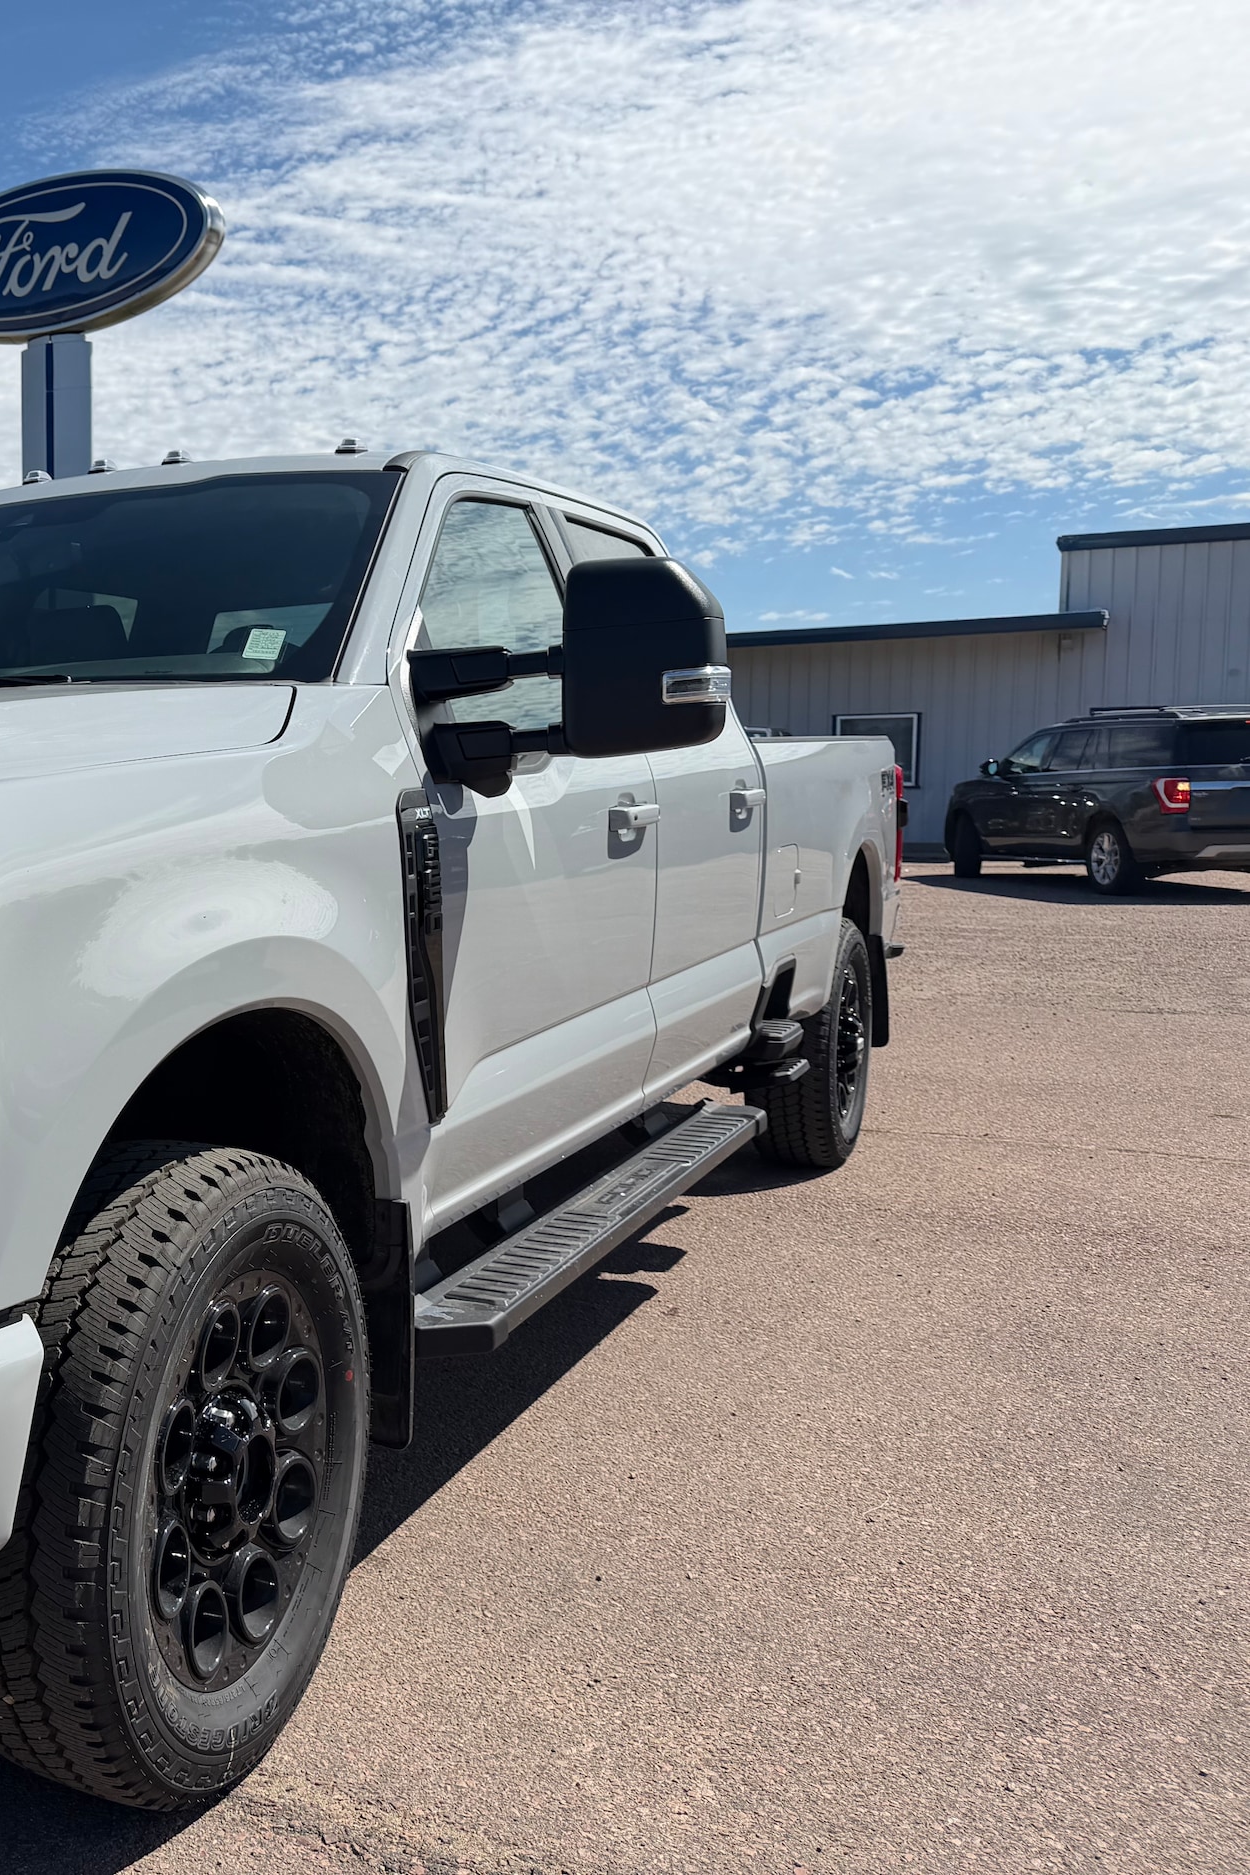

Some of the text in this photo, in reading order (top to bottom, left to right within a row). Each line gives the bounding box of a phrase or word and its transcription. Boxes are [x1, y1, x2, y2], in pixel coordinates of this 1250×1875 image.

[415, 808, 430, 819] XLT
[263, 1222, 346, 1301] DUELER
[148, 1664, 279, 1751] BRIDGESTONE
